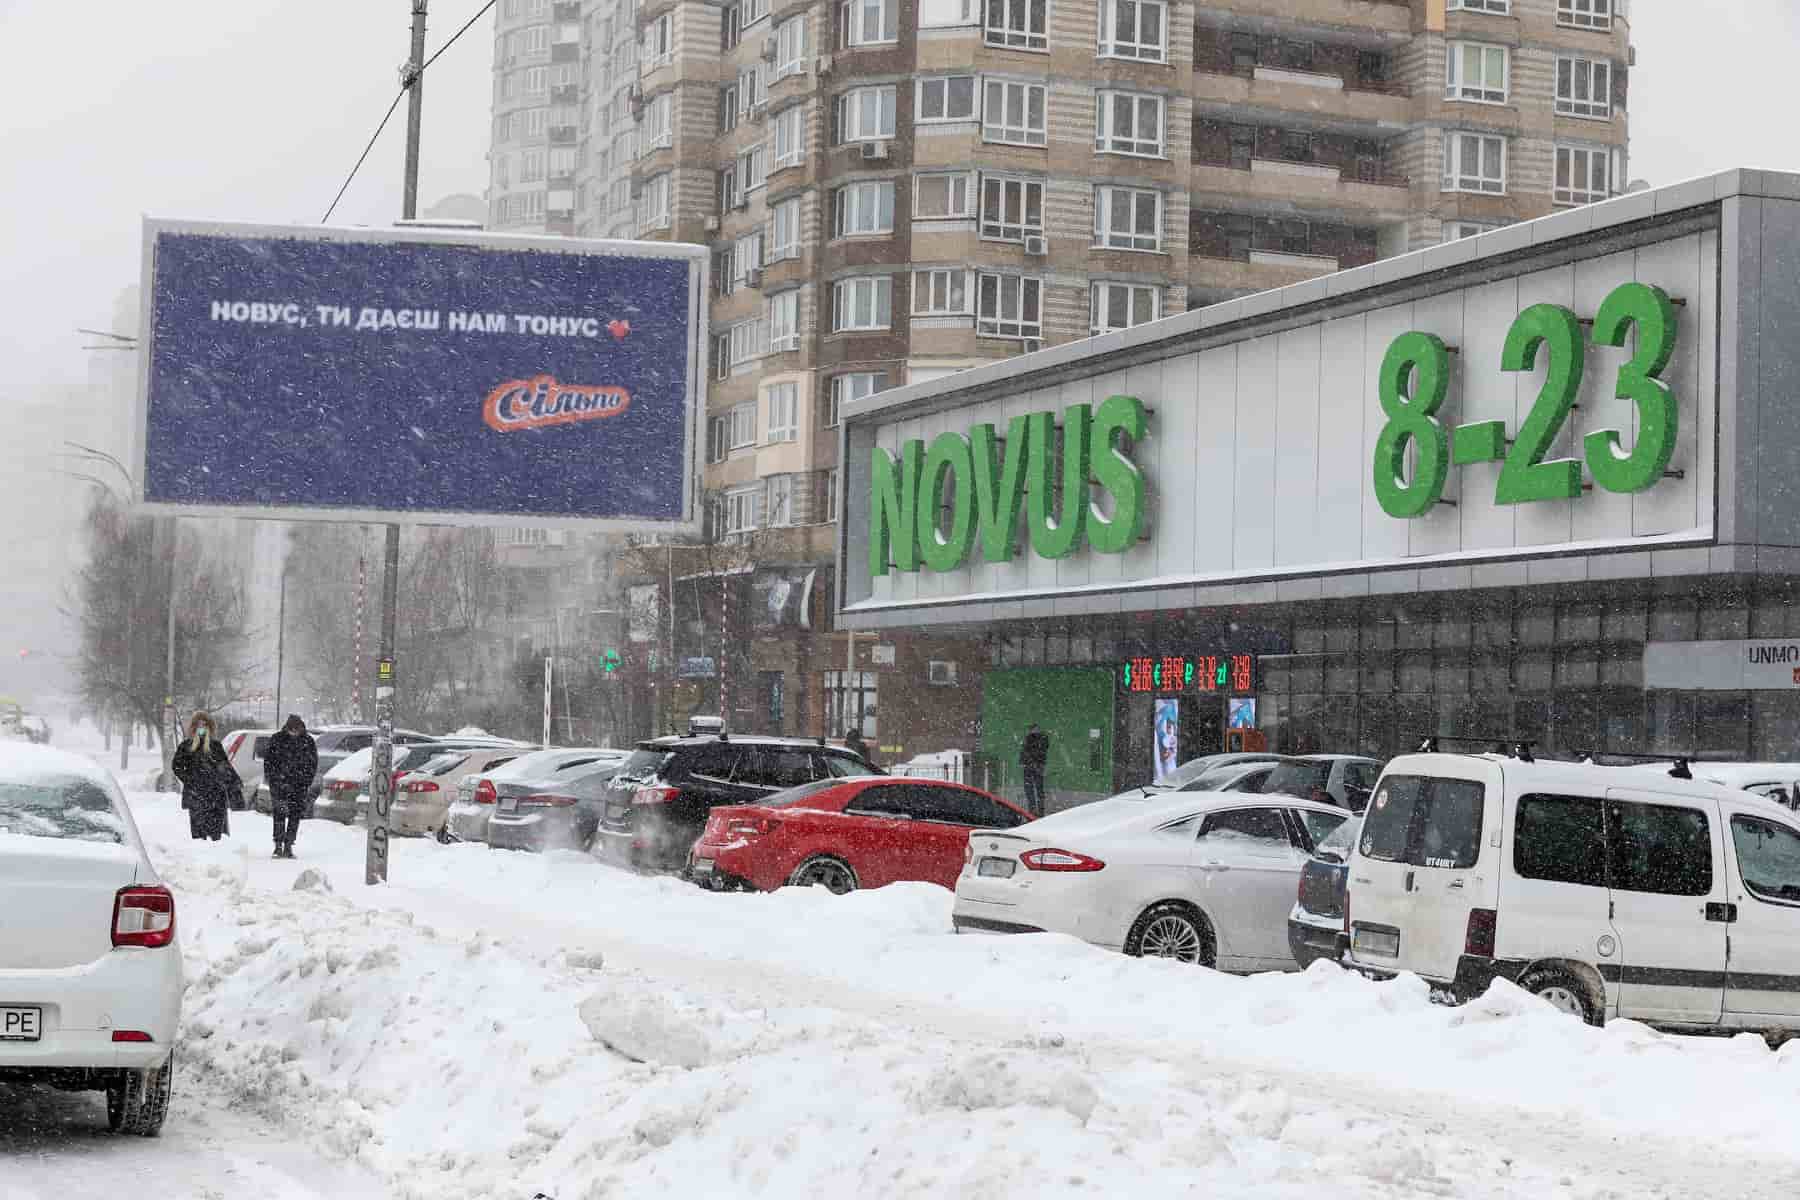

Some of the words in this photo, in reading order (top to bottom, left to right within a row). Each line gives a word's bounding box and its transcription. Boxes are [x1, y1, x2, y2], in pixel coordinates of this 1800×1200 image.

[211, 300, 307, 329] НОВУС,
[316, 304, 351, 327] ТИ
[355, 307, 440, 332] ДАЄШ
[449, 311, 506, 334] НАМ
[514, 314, 599, 338] ТОНУС
[495, 380, 622, 424] Сільпо
[1373, 282, 1680, 519] 8-23
[869, 395, 1148, 577] NOVUS
[6, 1012, 34, 1033] PE
